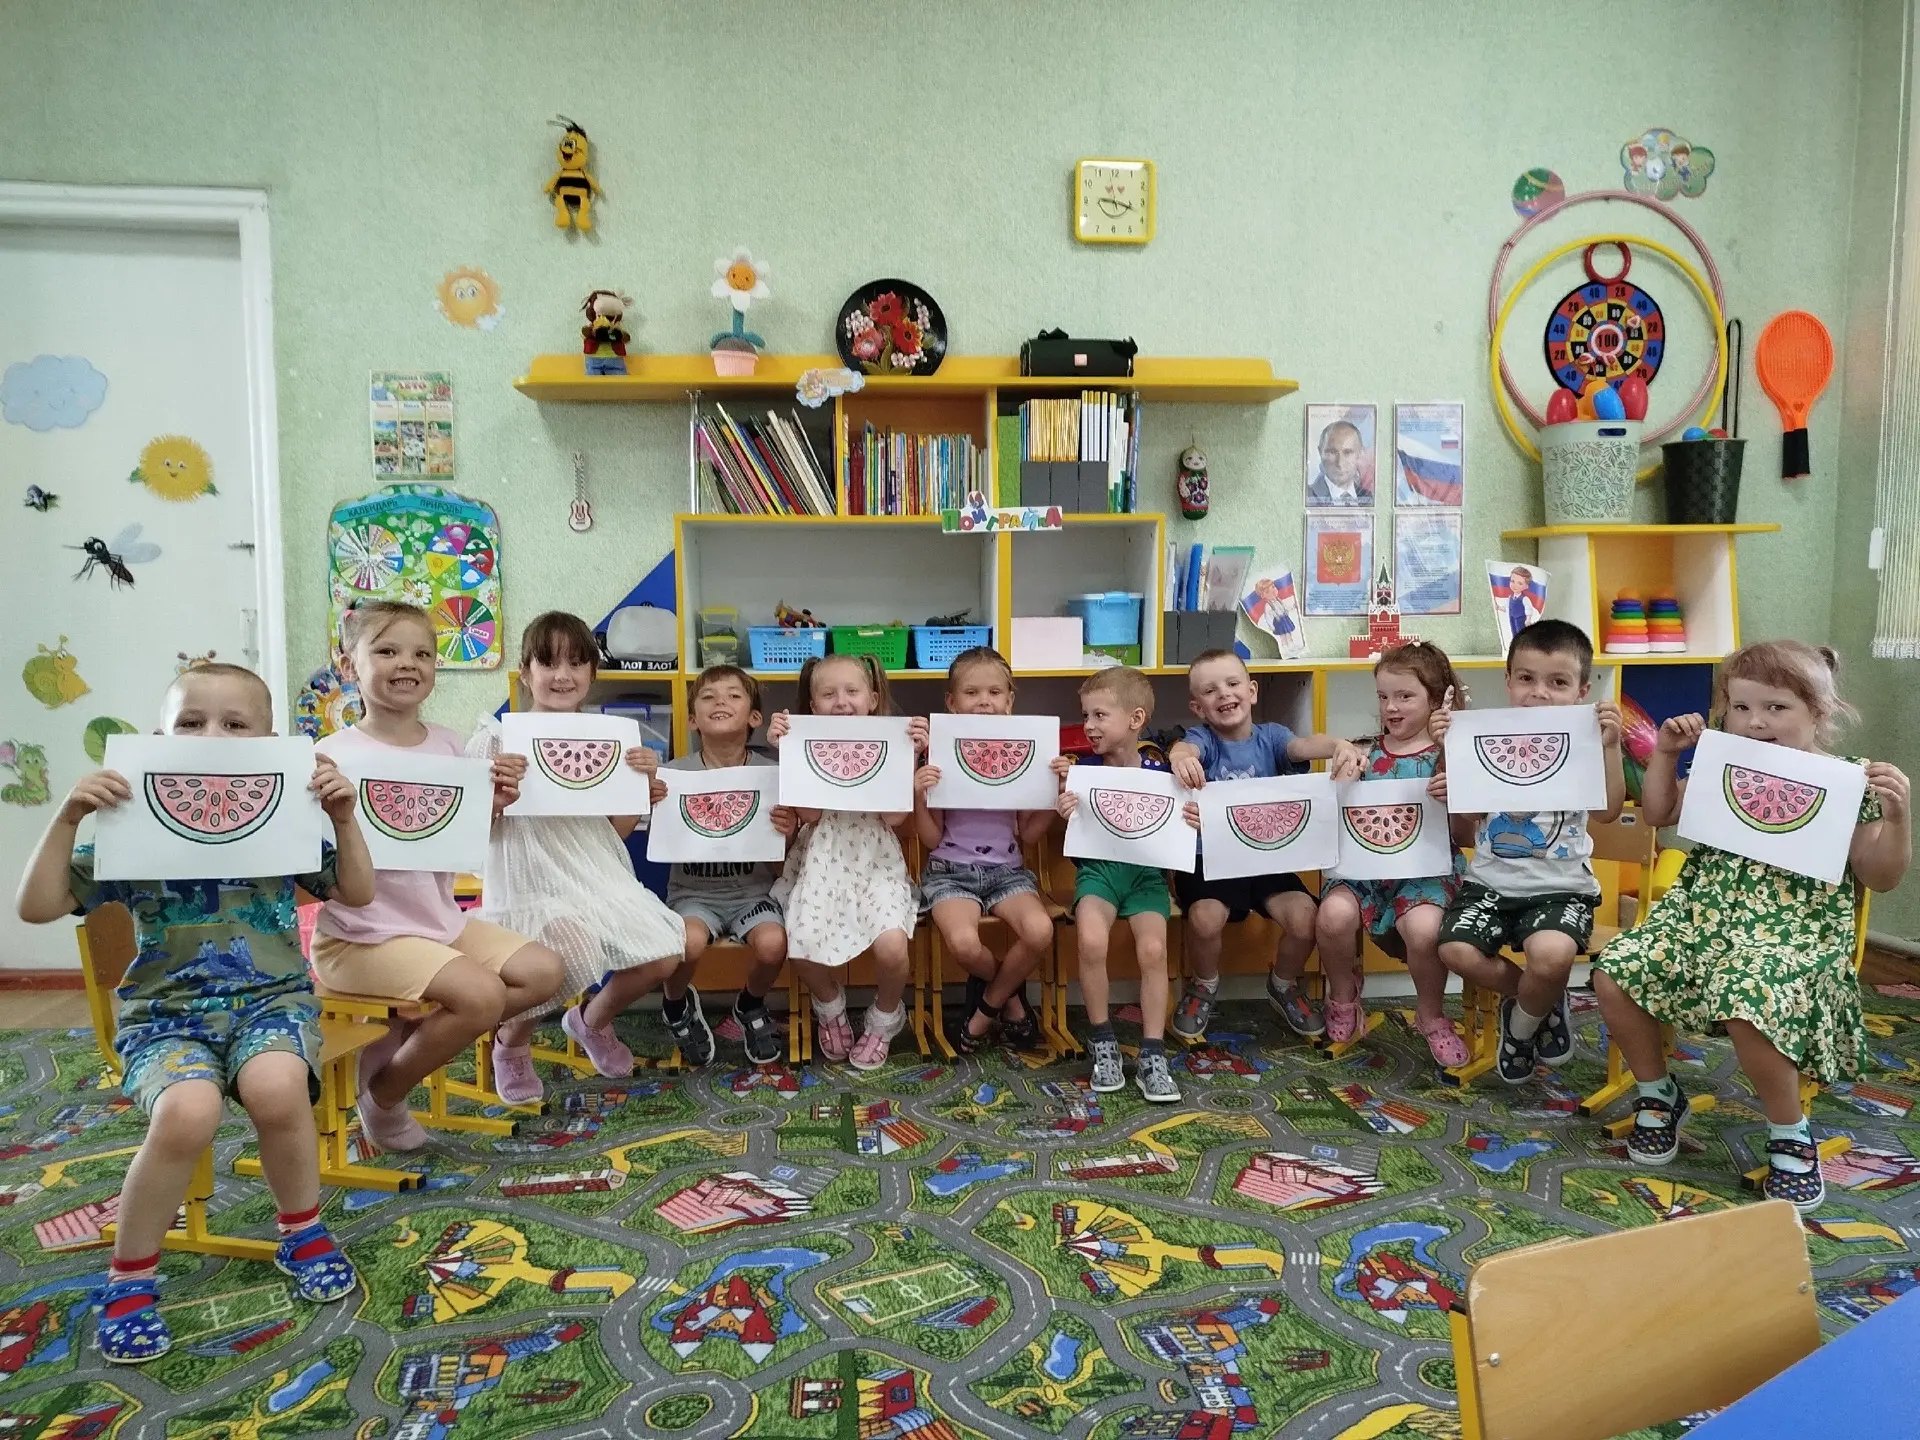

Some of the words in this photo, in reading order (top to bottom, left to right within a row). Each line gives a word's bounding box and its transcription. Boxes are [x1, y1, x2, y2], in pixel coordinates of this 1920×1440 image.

[1095, 169, 1102, 178] 11
[1111, 169, 1120, 178] 12
[1130, 170, 1133, 178] 1
[1084, 180, 1093, 188] 10
[1095, 225, 1099, 233] 7
[1590, 288, 1600, 299] 40
[1616, 287, 1625, 297] 20
[1568, 302, 1579, 312] 20
[1554, 325, 1565, 335] 40
[1598, 333, 1619, 347] 100
[1555, 350, 1565, 360] 20
[1647, 346, 1657, 356] 40
[1566, 371, 1577, 381] 40
[348, 500, 399, 517] КАЛЕНДАРЬ
[420, 500, 463, 515] ПРИРОДЫ
[647, 662, 672, 670] LOVE
[1451, 892, 1499, 932] ORIINAL
